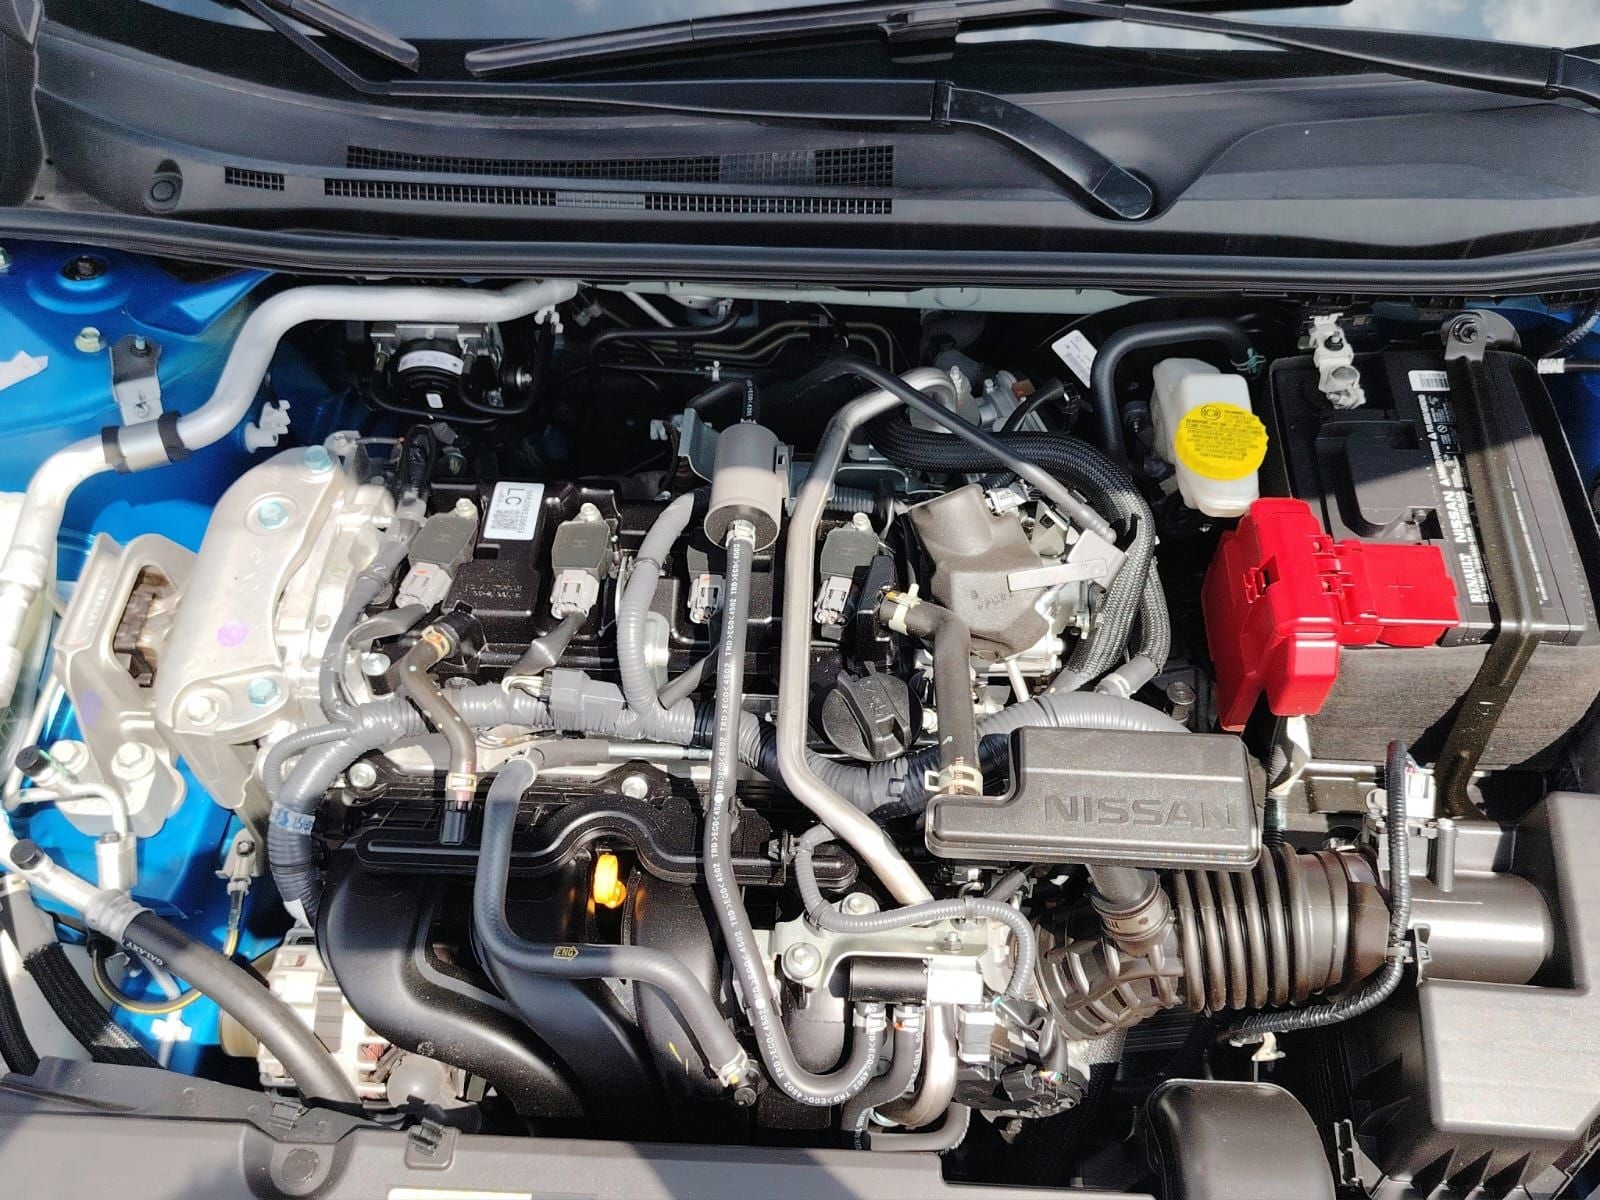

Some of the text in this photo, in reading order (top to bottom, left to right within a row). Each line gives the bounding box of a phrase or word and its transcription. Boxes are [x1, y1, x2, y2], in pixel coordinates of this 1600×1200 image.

[505, 488, 526, 505] LC
[1442, 491, 1468, 543] NISSAN
[1459, 553, 1484, 603] RENAULT
[1044, 796, 1236, 831] NISSAN
